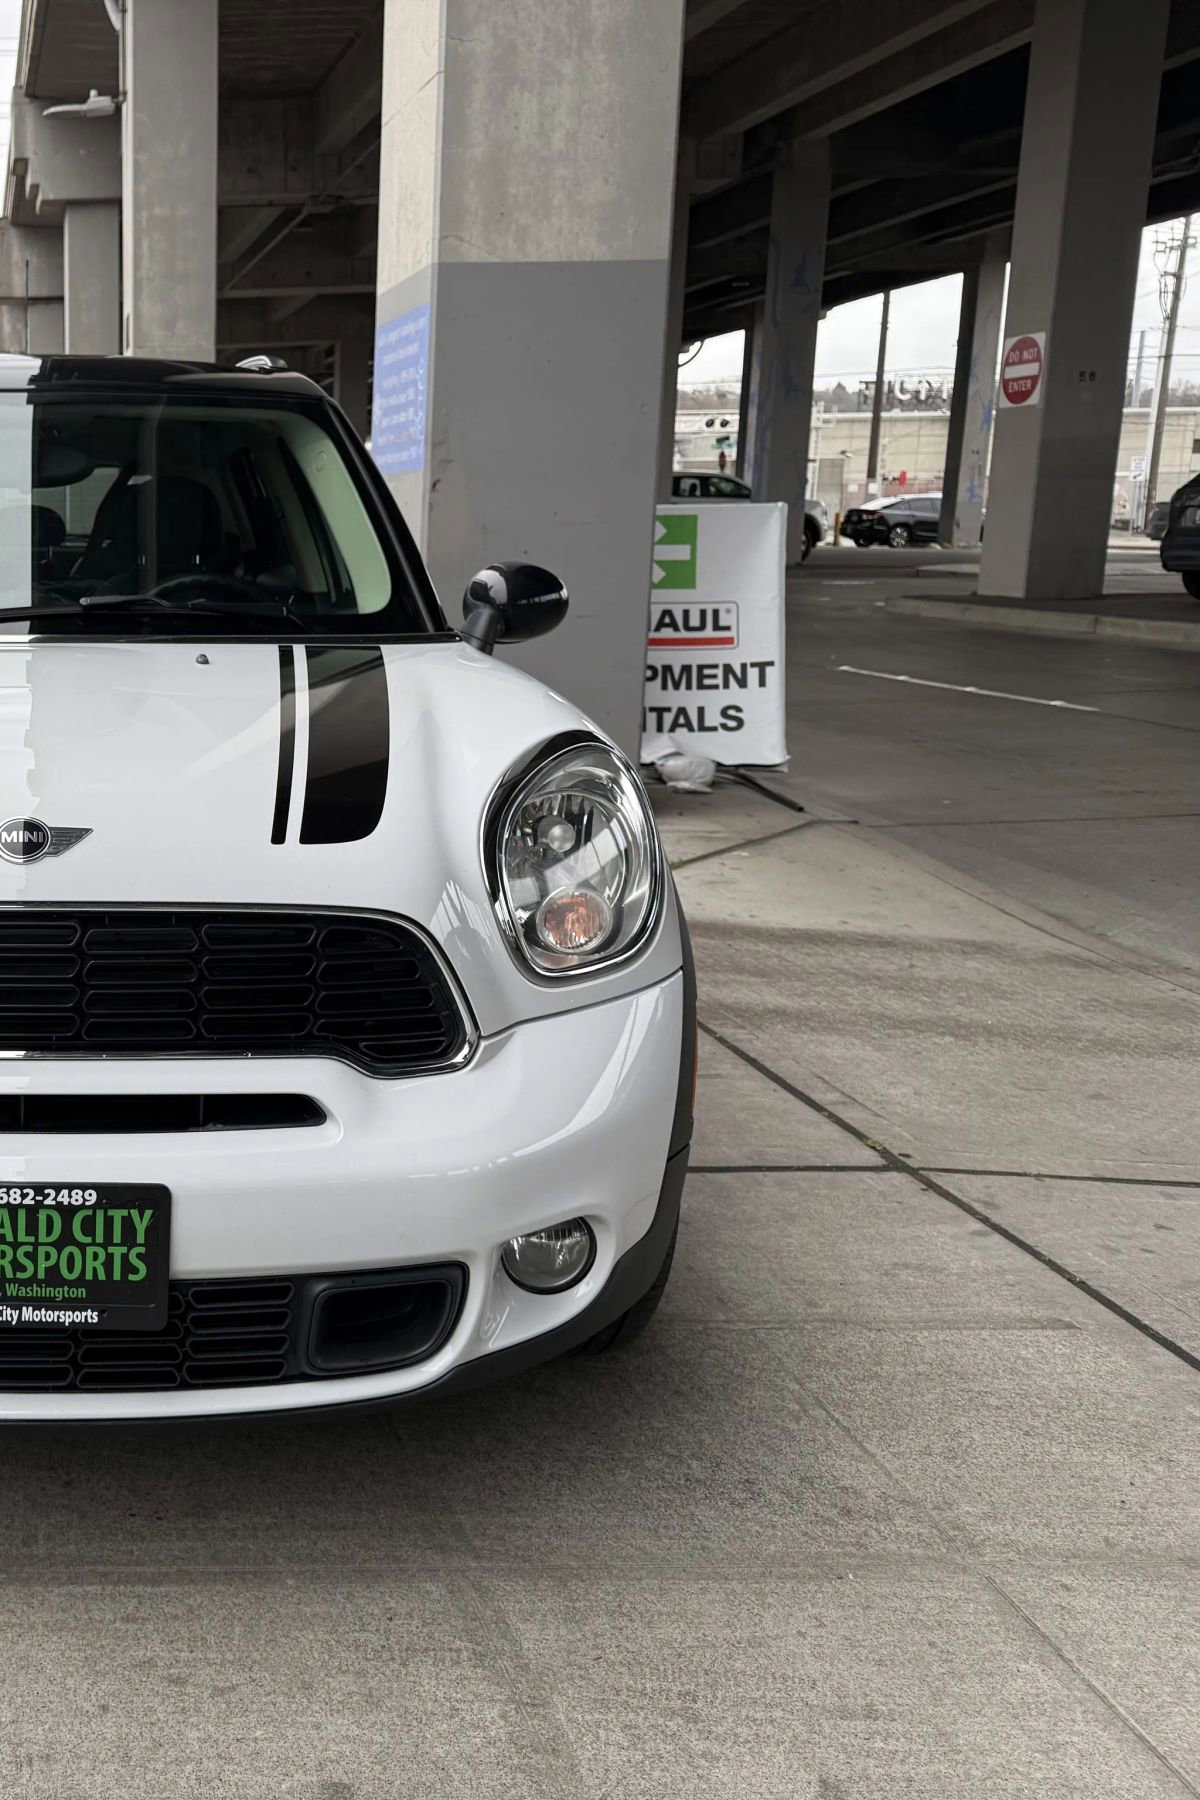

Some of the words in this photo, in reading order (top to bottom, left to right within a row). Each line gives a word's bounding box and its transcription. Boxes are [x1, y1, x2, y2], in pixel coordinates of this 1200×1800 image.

[1009, 351, 1020, 363] DO
[1023, 347, 1038, 361] NOT
[1008, 379, 1032, 393] ENTER
[642, 704, 745, 733] TALS
[1, 830, 44, 843] MINI
[72, 1208, 154, 1244] CITY
[5, 1282, 87, 1302] Washington
[21, 1306, 99, 1327] Motorsports
